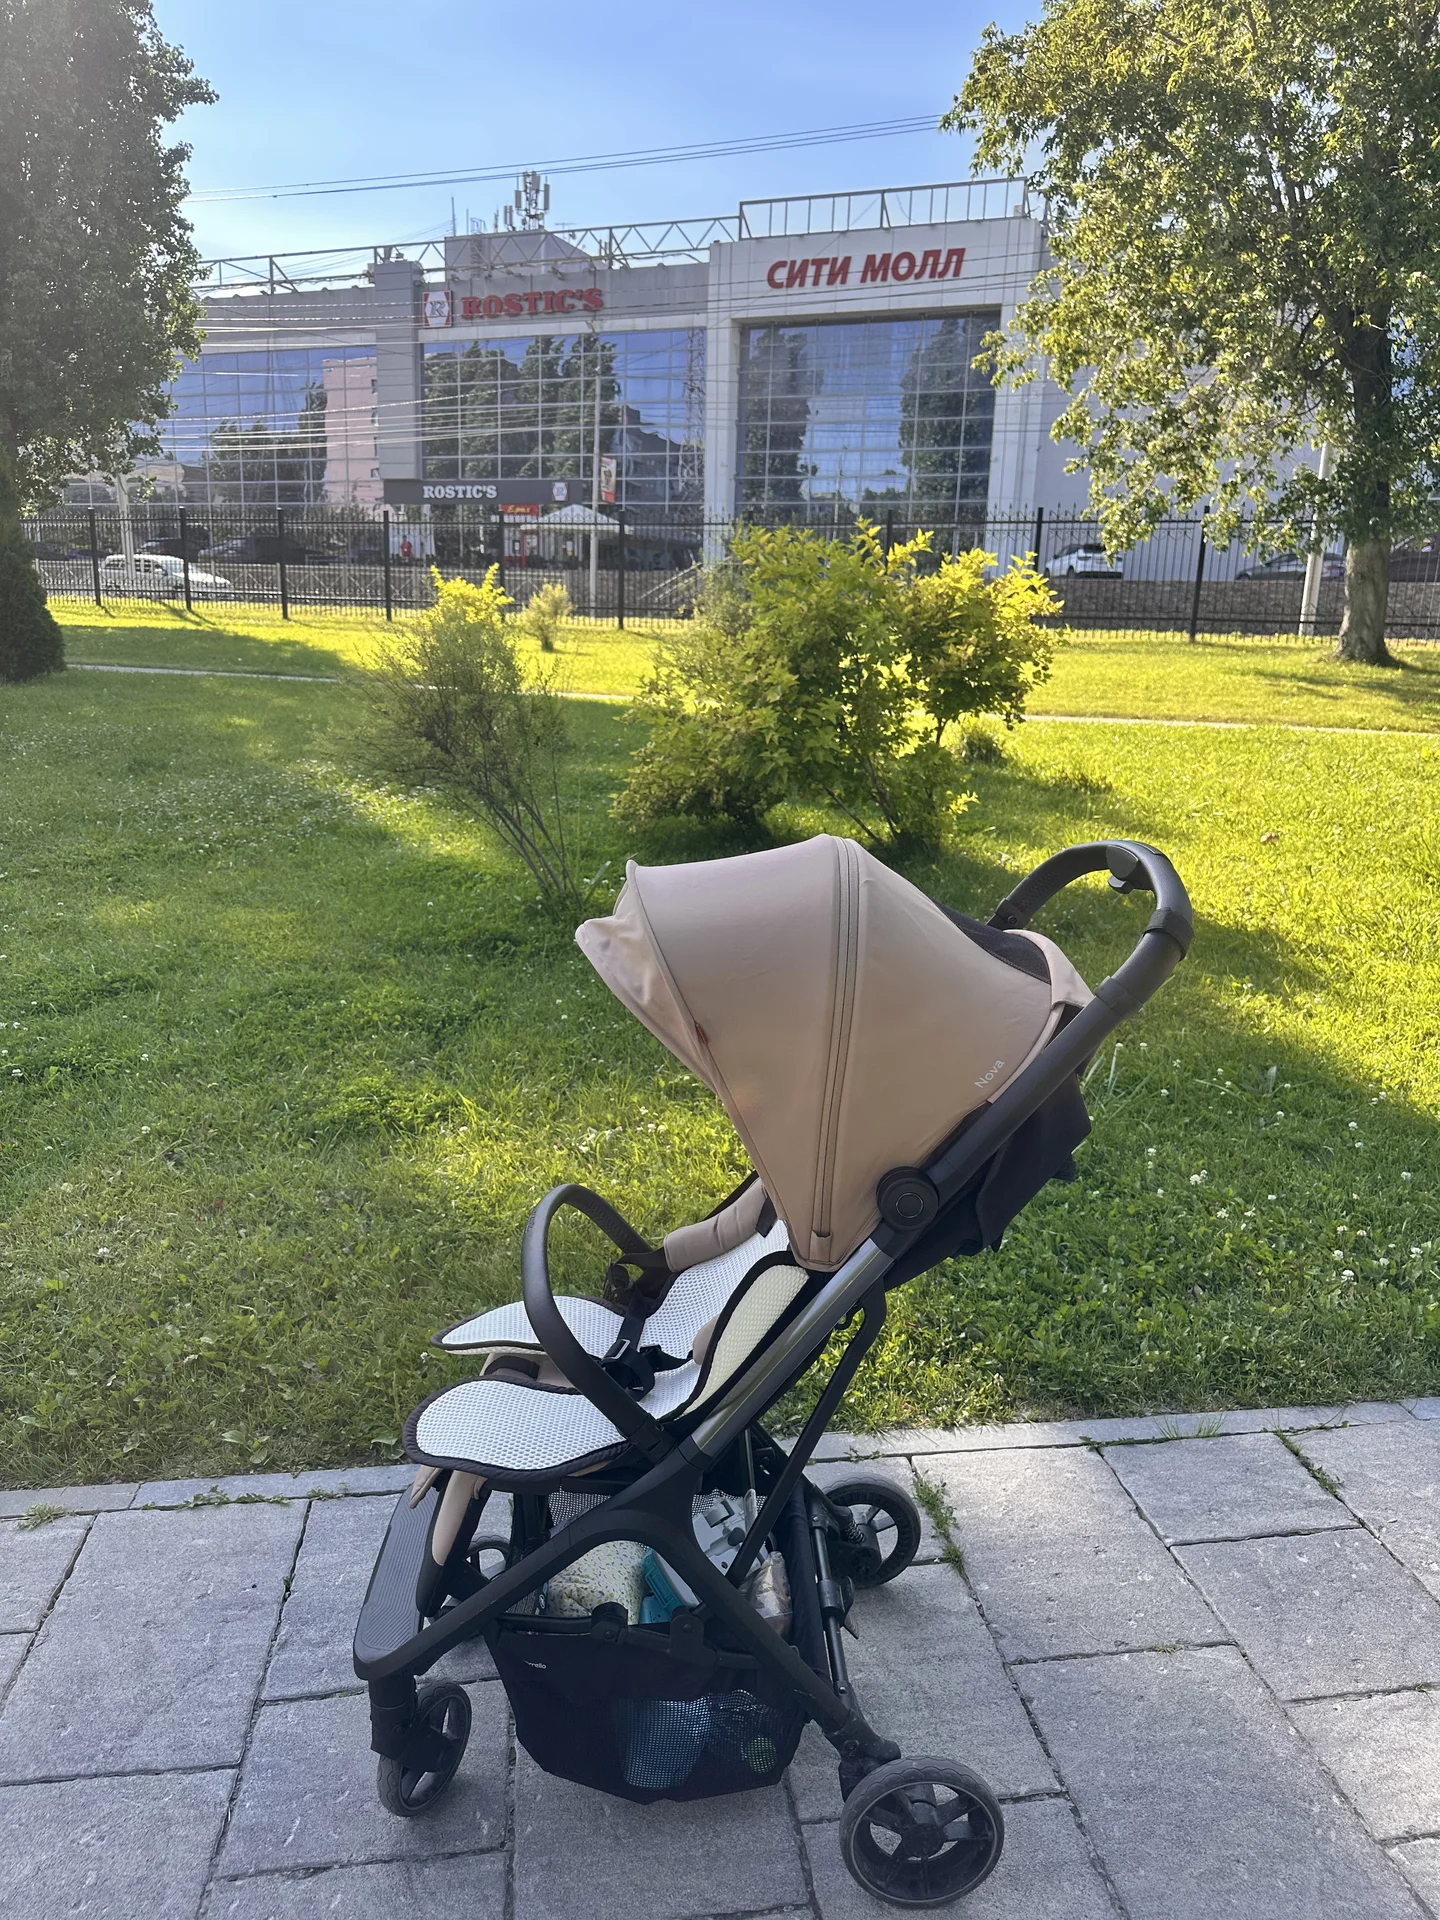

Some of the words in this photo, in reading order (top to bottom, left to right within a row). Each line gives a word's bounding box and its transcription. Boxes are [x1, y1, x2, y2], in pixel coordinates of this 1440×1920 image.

[767, 256, 852, 289] СИТИ
[860, 247, 966, 283] МОЛЛ
[461, 288, 604, 320] ROSTIC'S
[423, 485, 498, 499] ROSTIC'S
[974, 1060, 1005, 1088] Nova
